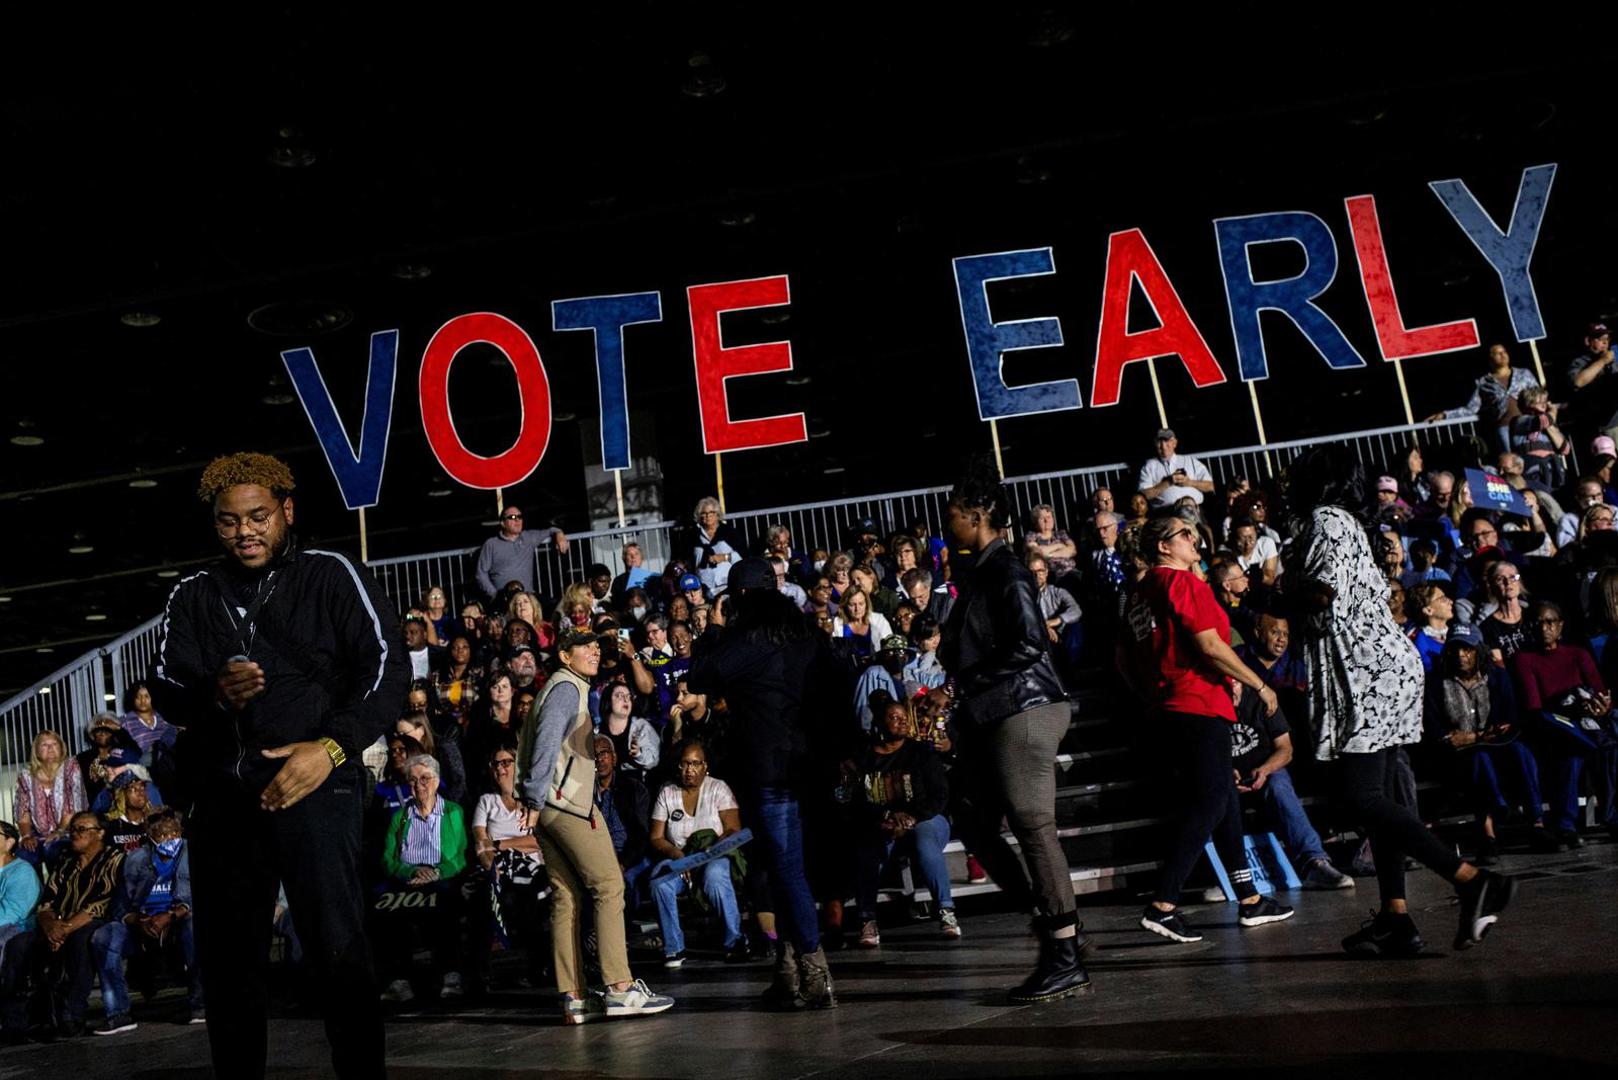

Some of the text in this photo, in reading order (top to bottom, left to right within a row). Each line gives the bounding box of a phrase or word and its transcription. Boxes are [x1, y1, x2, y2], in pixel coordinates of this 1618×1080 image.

[280, 163, 1558, 510] VOTE EARLY
[1487, 482, 1511, 494] SHE
[1488, 491, 1514, 503] CAN
[374, 891, 438, 912] vote
